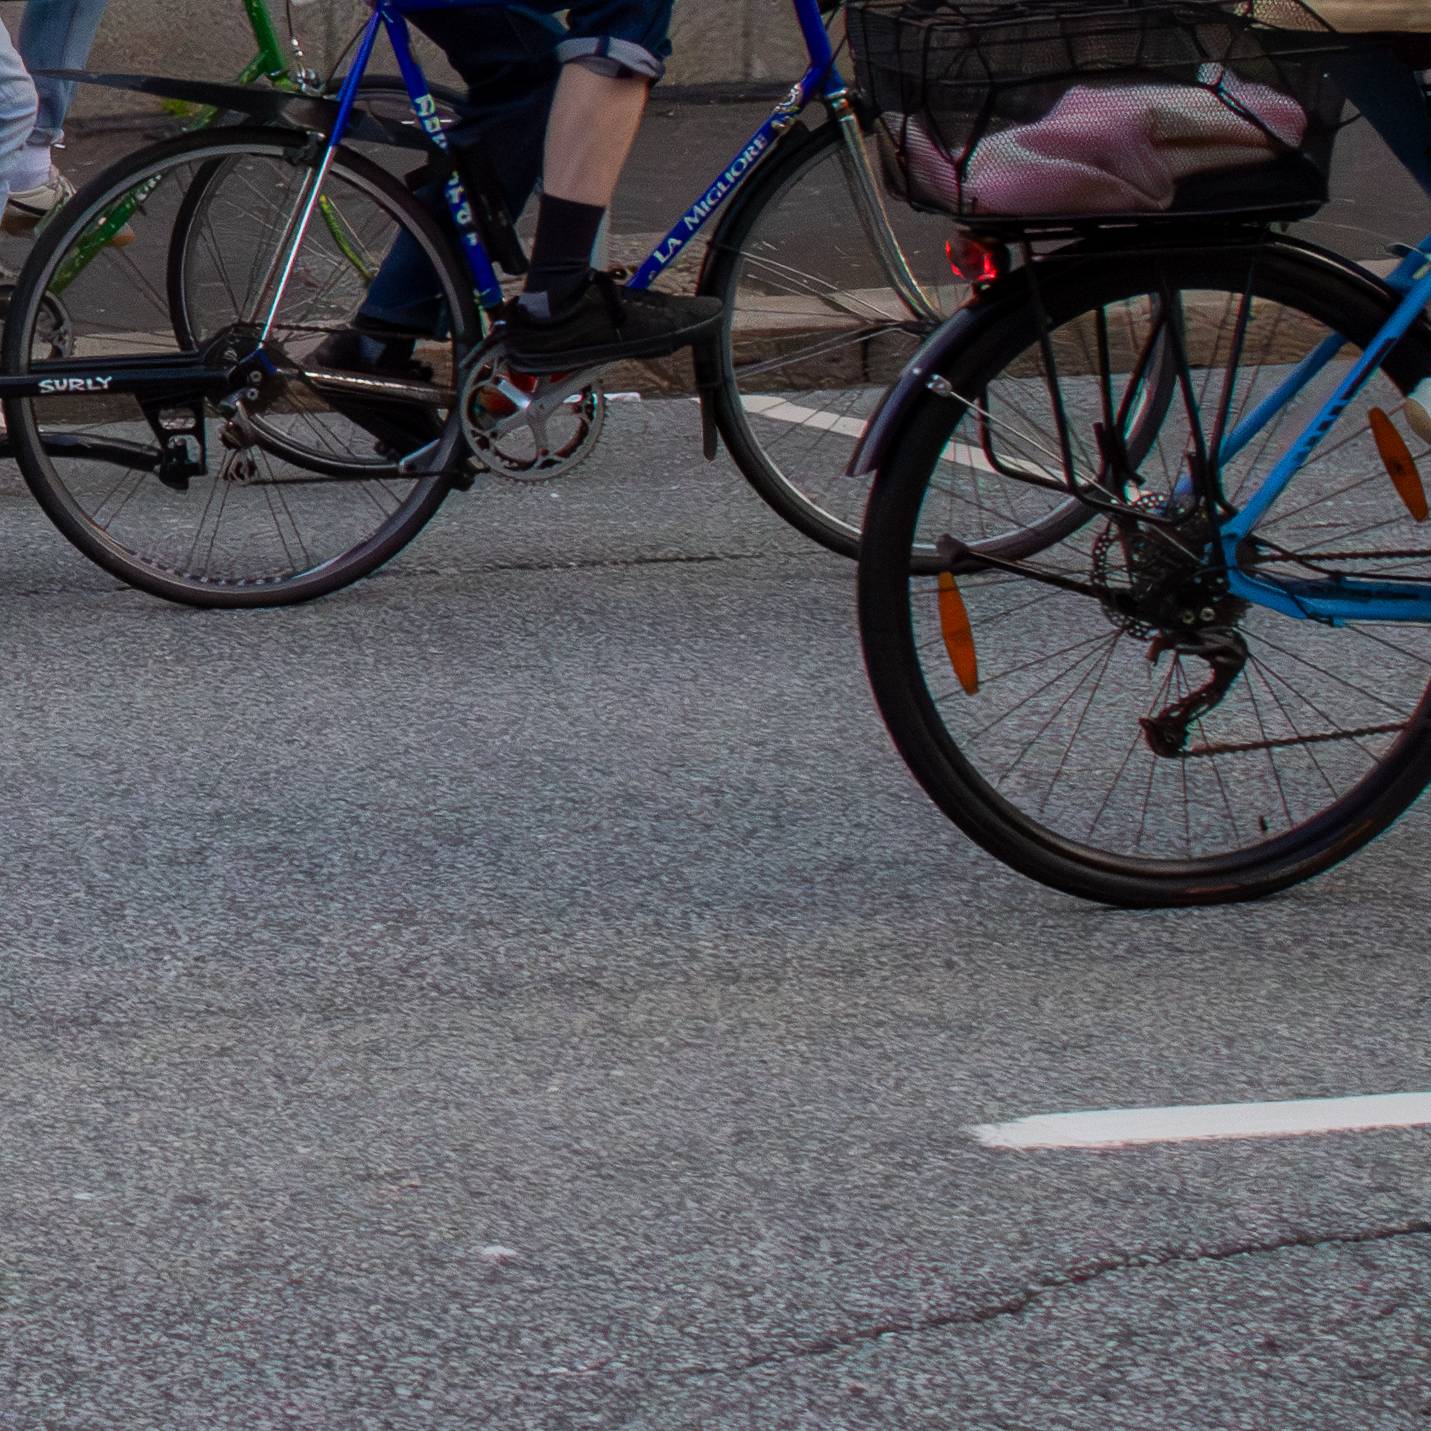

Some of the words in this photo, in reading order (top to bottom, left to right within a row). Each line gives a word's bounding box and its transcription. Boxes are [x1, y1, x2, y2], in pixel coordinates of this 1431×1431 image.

[653, 236, 683, 265] LA
[682, 133, 768, 231] MIGLIORE
[38, 376, 114, 395] SURLY
